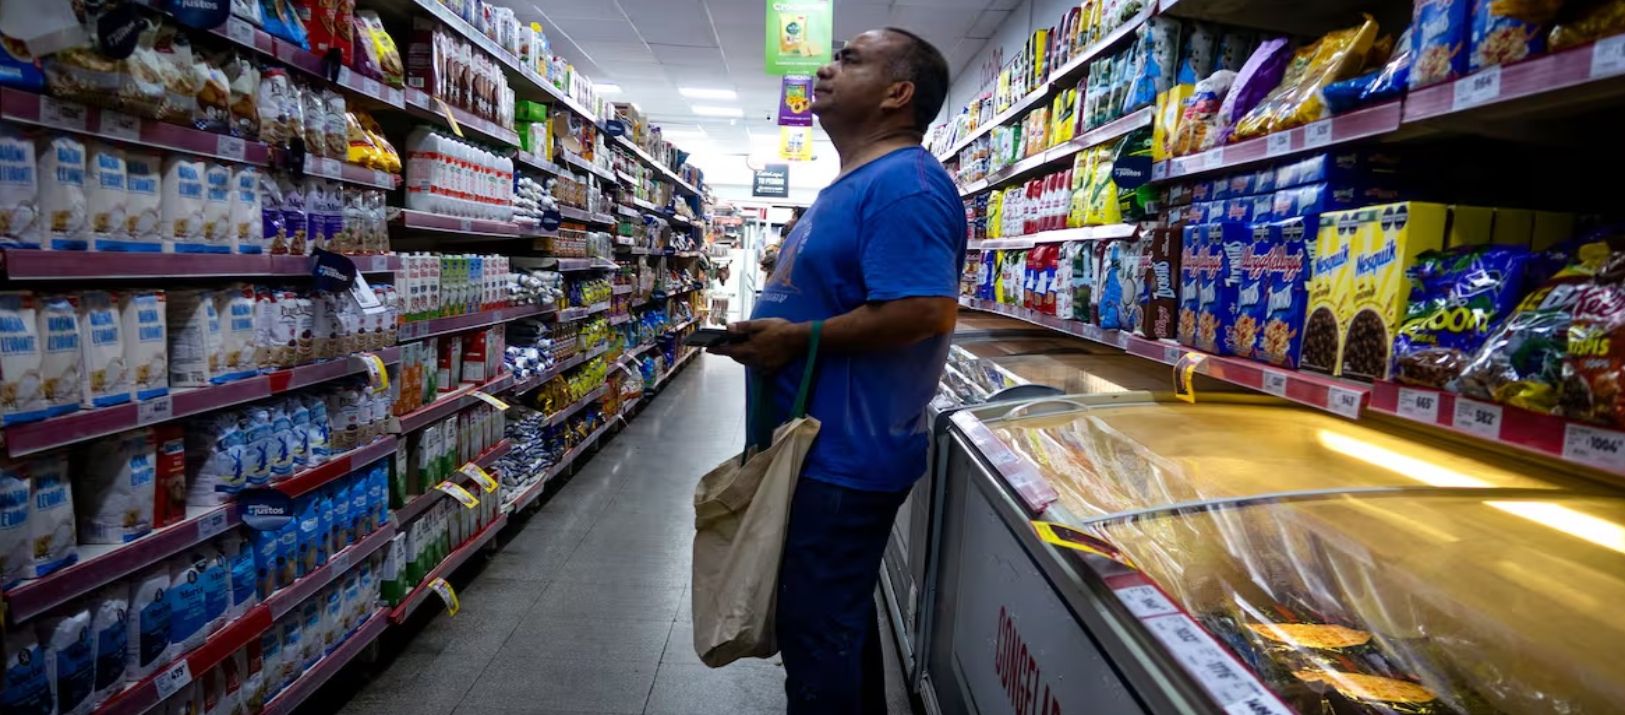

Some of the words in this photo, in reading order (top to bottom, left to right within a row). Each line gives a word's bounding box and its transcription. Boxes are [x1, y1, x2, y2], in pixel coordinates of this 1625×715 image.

[1356, 239, 1396, 276] Nesquik
[1475, 409, 1493, 425] 582
[1590, 436, 1618, 452] 1004
